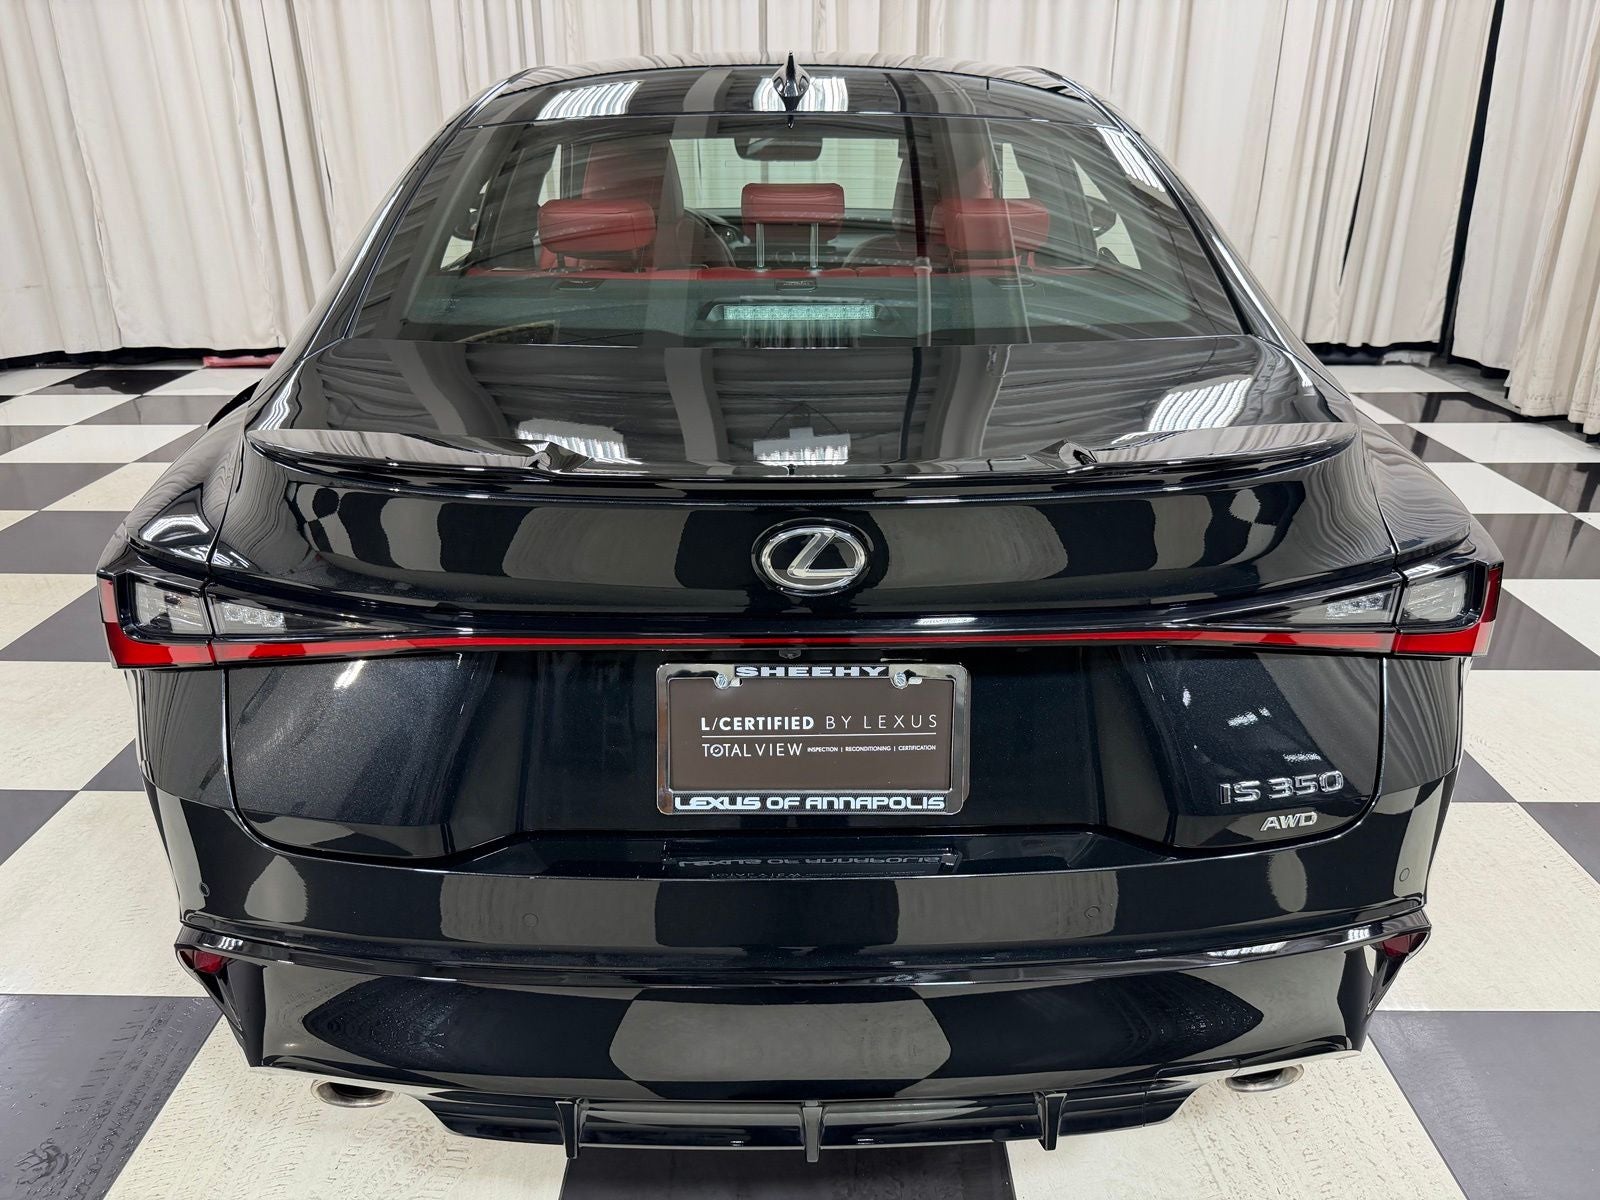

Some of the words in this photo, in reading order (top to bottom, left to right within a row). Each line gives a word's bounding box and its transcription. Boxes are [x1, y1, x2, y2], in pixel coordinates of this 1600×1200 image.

[736, 666, 887, 677] SHEEHY
[701, 716, 815, 731] L/CERTIFIED
[826, 715, 852, 729] BY
[863, 714, 938, 729] LEXUS
[702, 743, 752, 757] TOTAL
[756, 743, 803, 756] VIEW
[1219, 780, 1262, 805] IS
[1267, 770, 1344, 800] 350
[674, 796, 762, 810] LEXUS
[766, 796, 801, 810] OF
[805, 796, 946, 810] ANNAPOLIS
[1259, 811, 1318, 832] AWD
